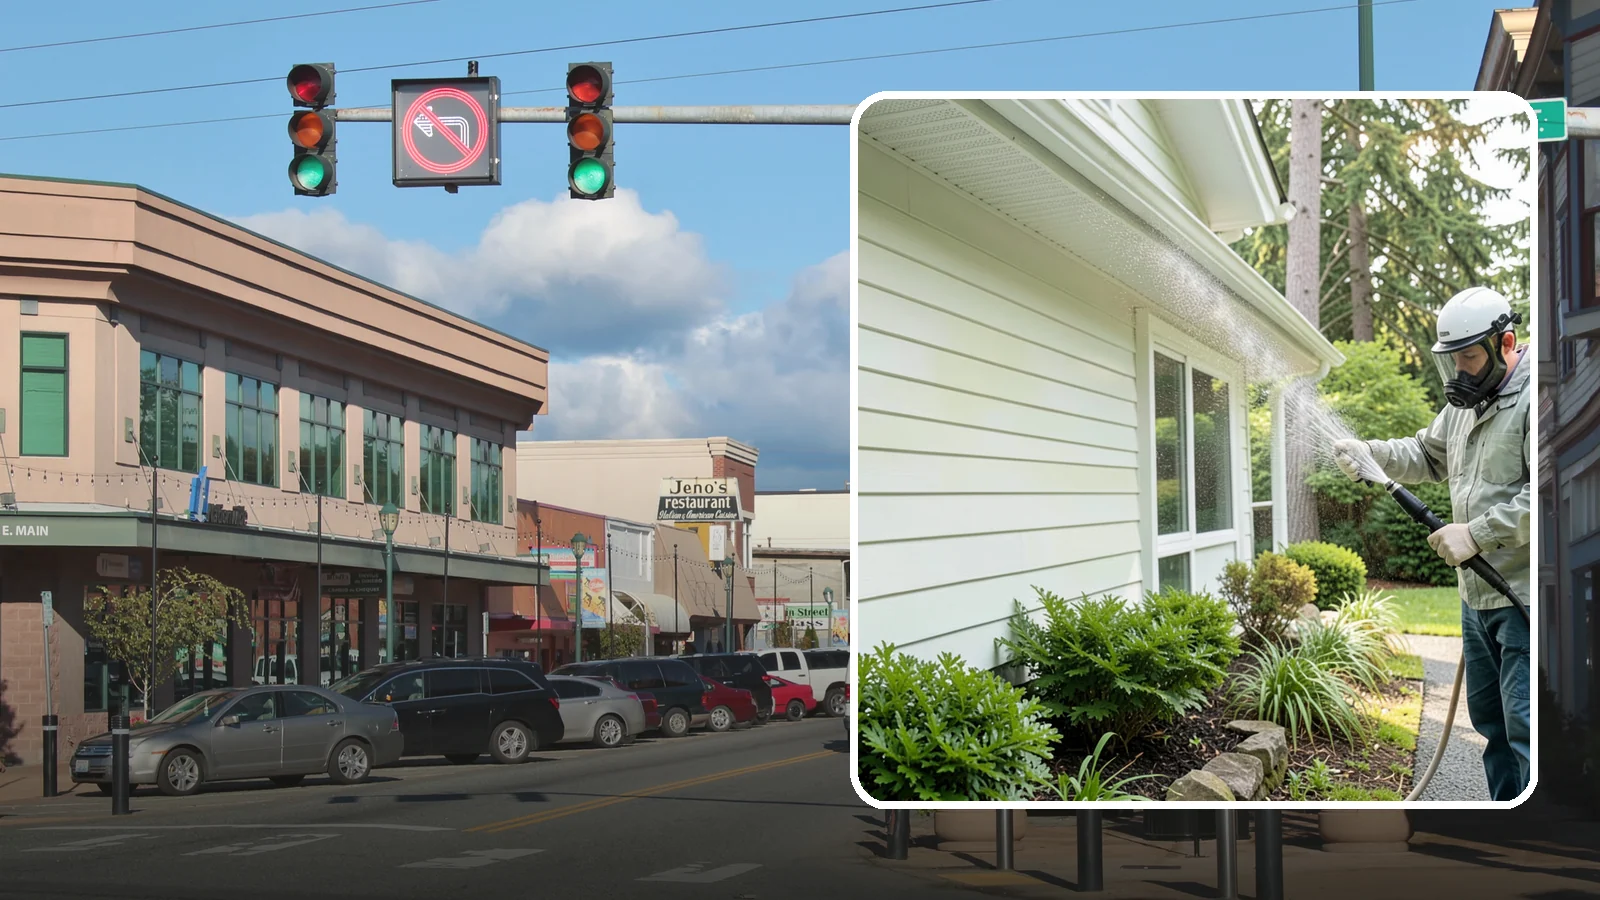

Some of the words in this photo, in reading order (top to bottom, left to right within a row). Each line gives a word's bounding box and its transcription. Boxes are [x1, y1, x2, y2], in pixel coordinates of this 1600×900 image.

[670, 480, 727, 494] Jeno's
[665, 497, 731, 509] restaurant
[658, 510, 682, 519] Italian
[686, 510, 714, 519] American
[715, 509, 737, 519] Cuisine
[2, 525, 13, 536] E.
[16, 525, 48, 536] MAIN
[797, 608, 828, 616] Street
